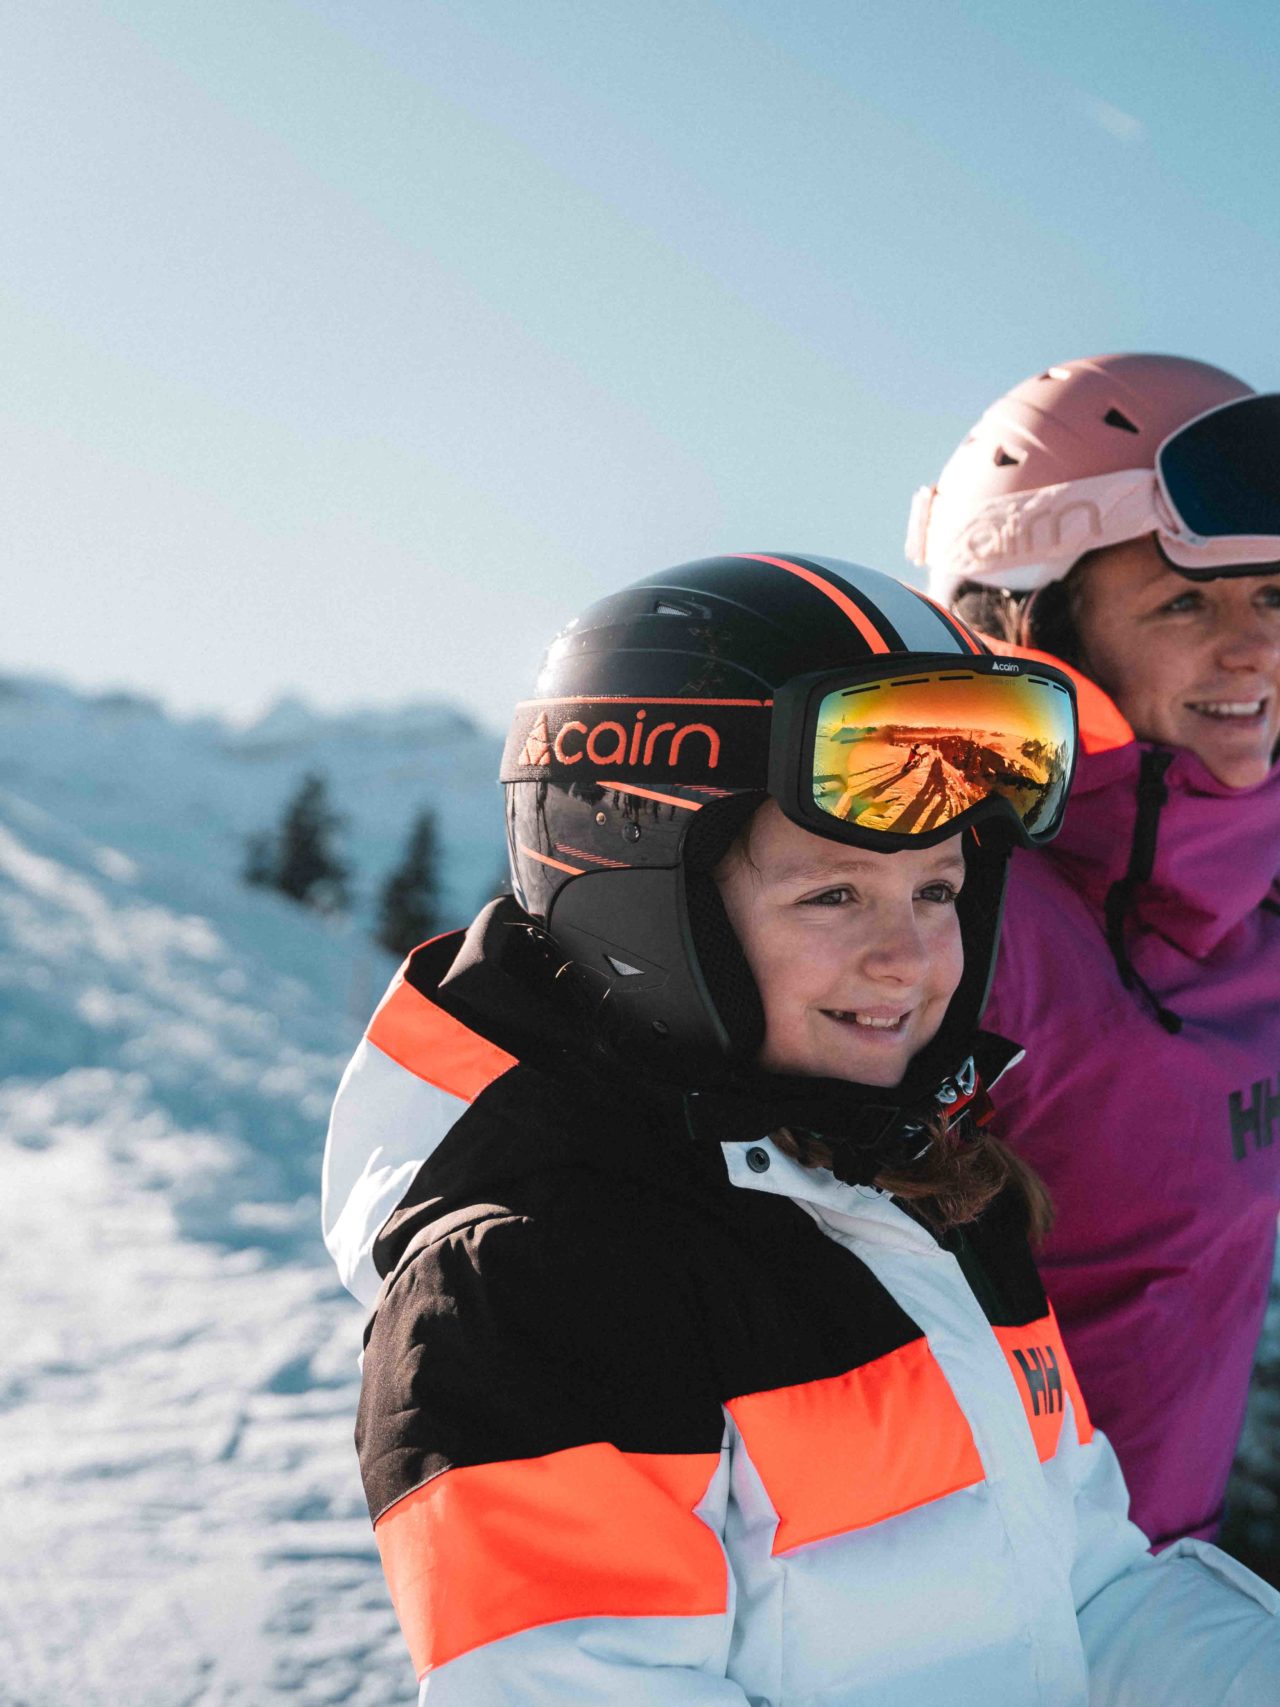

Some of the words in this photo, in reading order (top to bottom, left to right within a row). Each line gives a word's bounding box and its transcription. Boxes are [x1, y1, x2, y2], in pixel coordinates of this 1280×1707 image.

[999, 662, 1020, 672] cairn
[555, 709, 720, 768] cairn
[1012, 1346, 1063, 1416] HH
